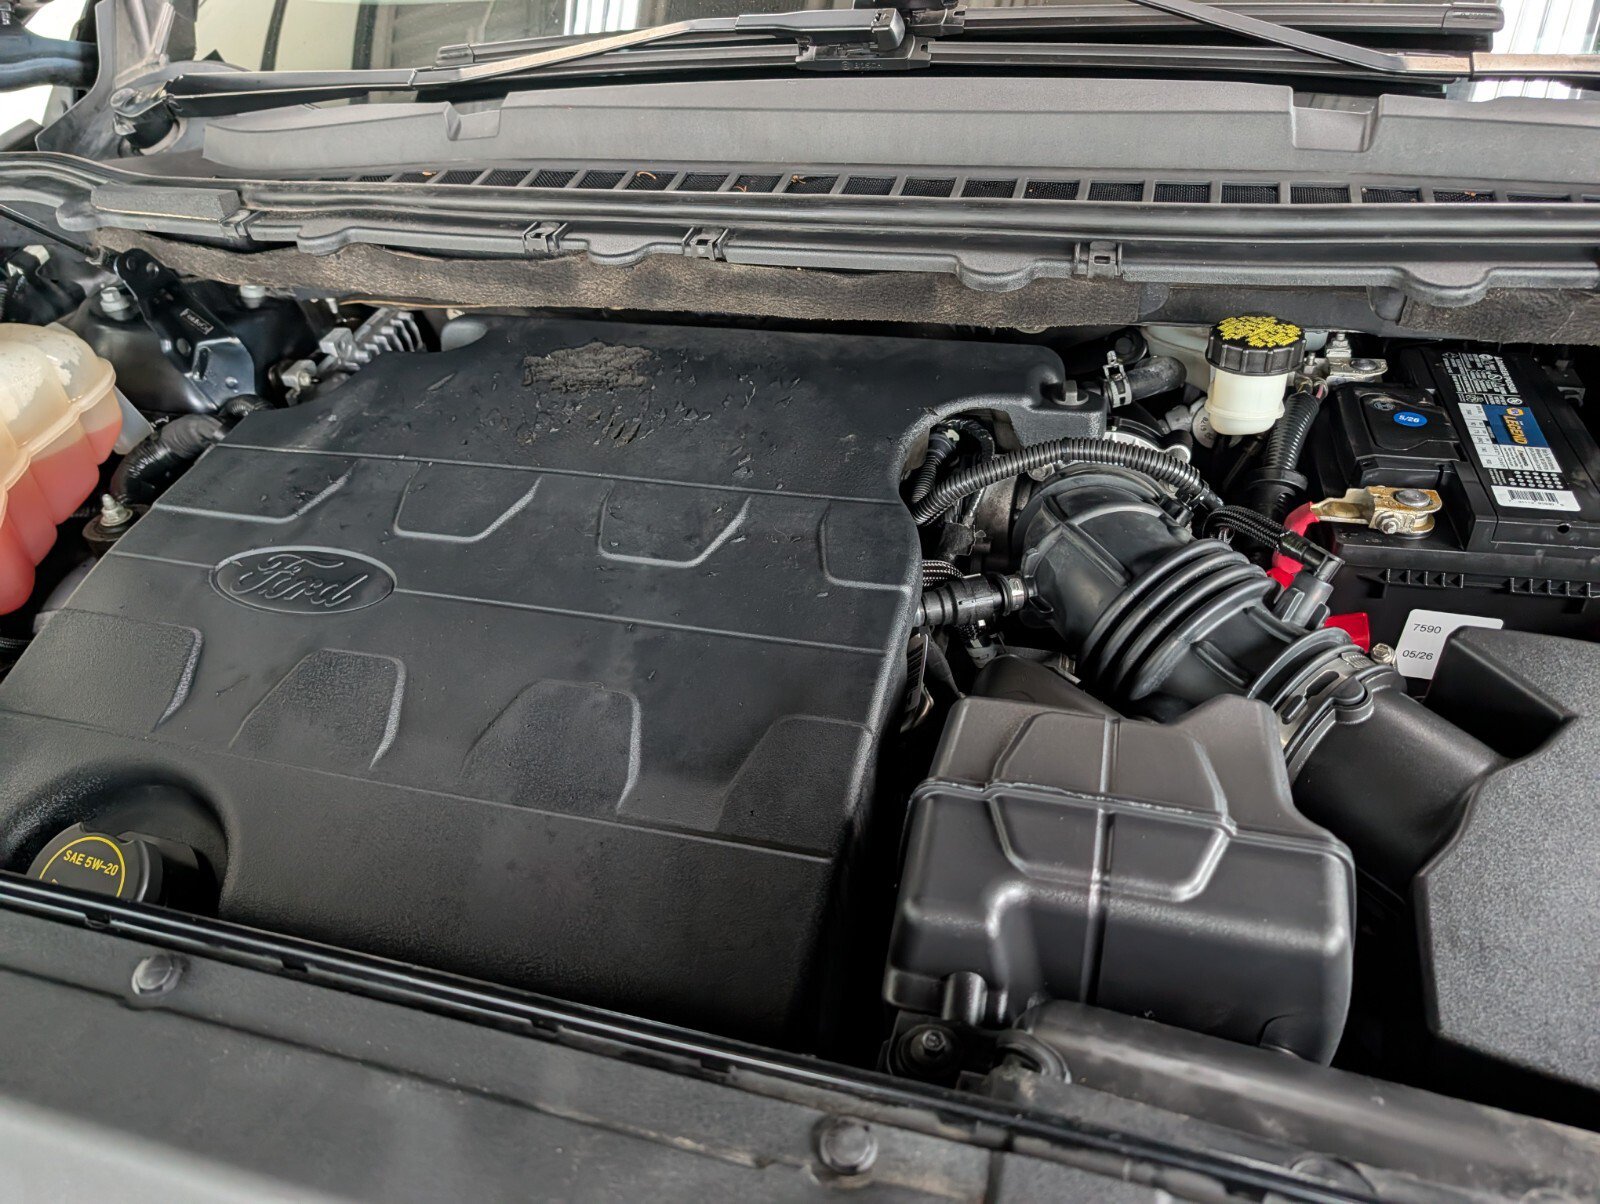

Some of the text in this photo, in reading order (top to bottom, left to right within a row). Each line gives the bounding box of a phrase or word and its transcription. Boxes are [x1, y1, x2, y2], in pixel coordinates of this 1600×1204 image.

[1398, 414, 1420, 423] 5/26
[1503, 415, 1528, 444] LEGEND
[230, 553, 368, 607] Ford
[1413, 623, 1442, 634] 7590
[1402, 649, 1434, 661] 05/26
[63, 850, 119, 876] SAE 5W-20
